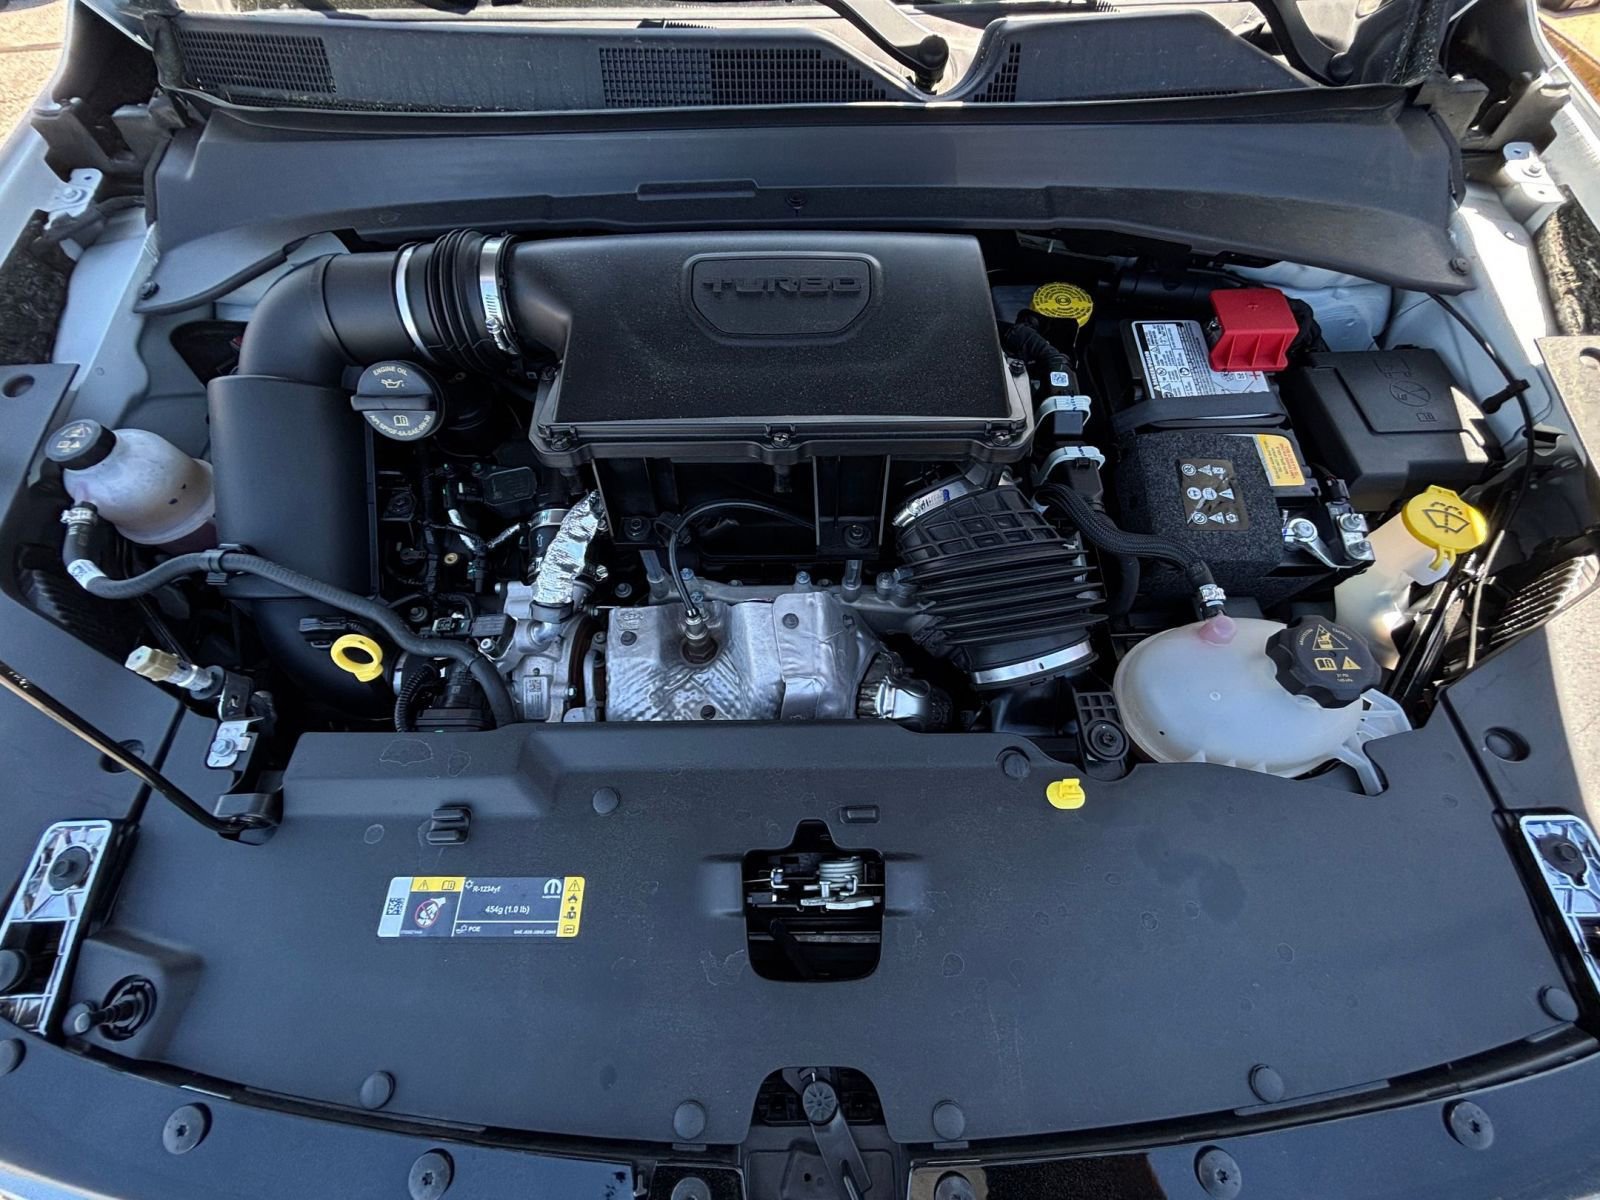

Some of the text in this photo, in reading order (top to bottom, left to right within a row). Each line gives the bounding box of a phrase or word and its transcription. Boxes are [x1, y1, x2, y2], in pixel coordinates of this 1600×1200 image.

[703, 277, 862, 294] TURBO
[373, 366, 408, 376] ENGINE OIL
[472, 886, 501, 894] R-1234yf
[485, 905, 530, 914] 454g (1.0 lb)
